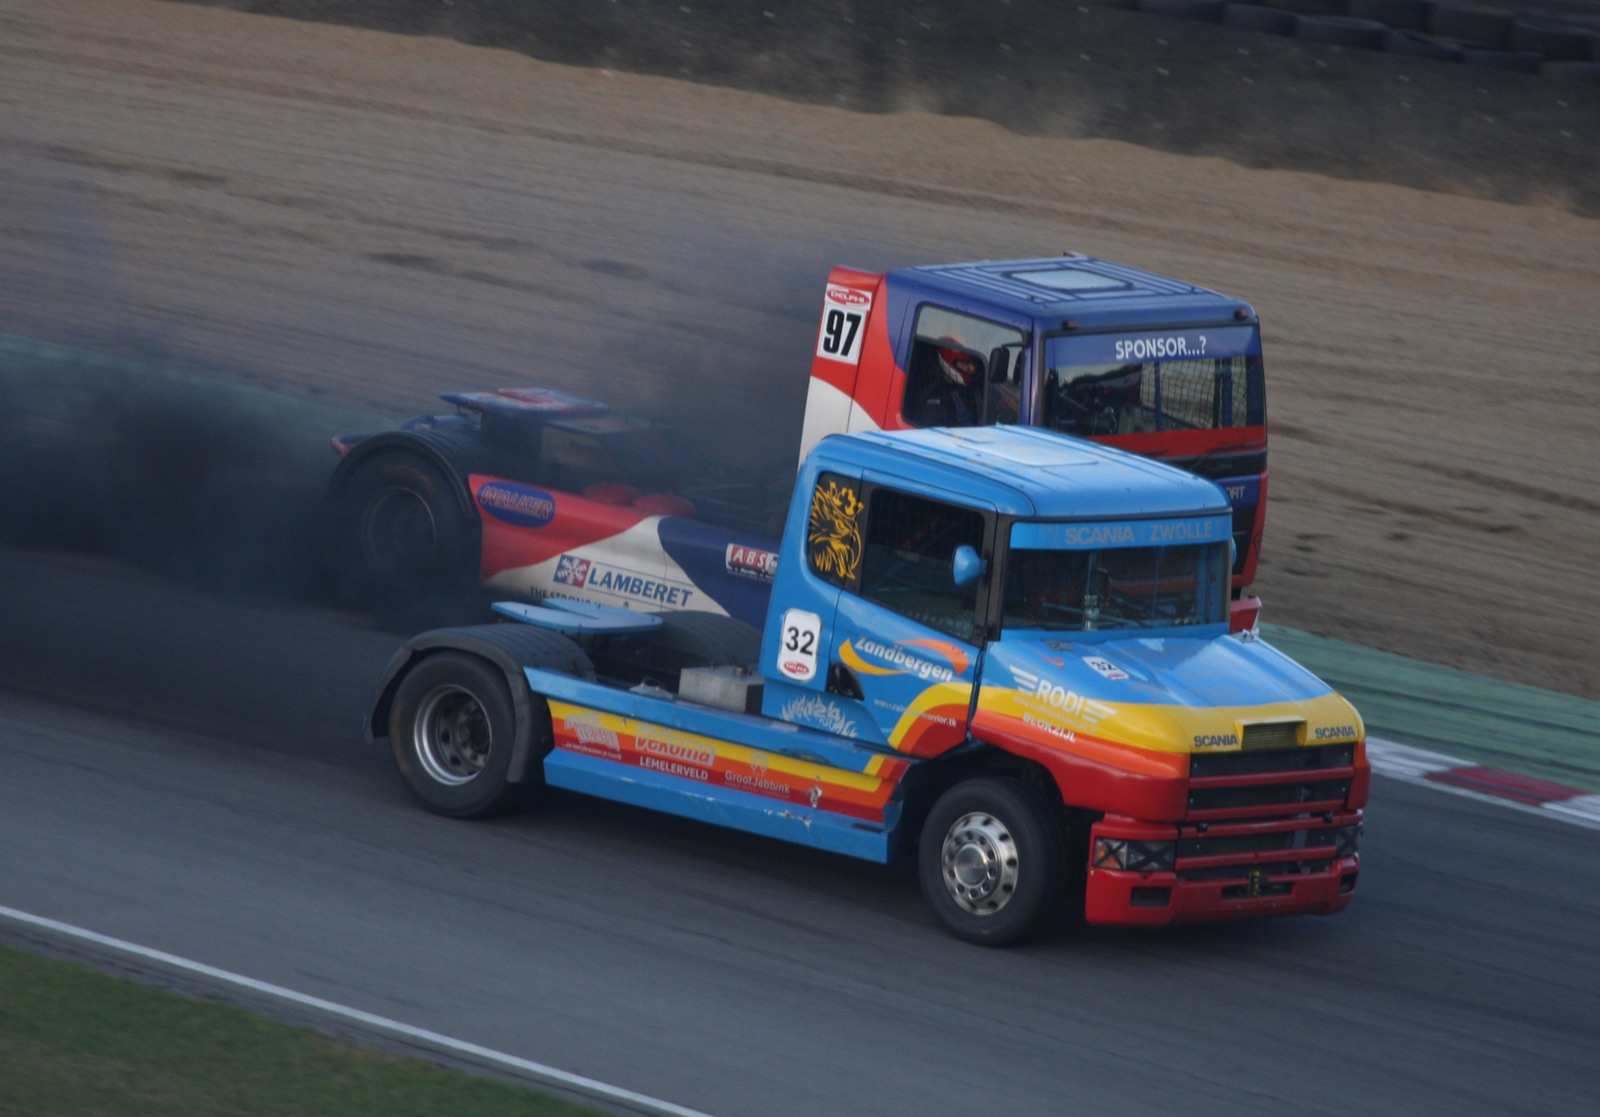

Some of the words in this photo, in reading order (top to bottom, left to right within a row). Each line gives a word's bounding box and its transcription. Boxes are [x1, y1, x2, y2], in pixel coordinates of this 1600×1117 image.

[830, 290, 866, 304] DELPHI
[823, 308, 862, 357] 97
[1115, 335, 1207, 361] SPONSOR...?
[480, 485, 553, 520] WALKER
[1065, 526, 1136, 545] SCANIA
[1149, 520, 1212, 541] ZWOLLE
[732, 546, 767, 568] ABS
[529, 586, 548, 600] THE
[588, 567, 694, 607] LAMBERET
[785, 625, 815, 656] 32
[853, 635, 954, 682] Zandbergen
[1090, 661, 1118, 671] 32
[1036, 679, 1085, 717] RODI
[1023, 712, 1077, 742] BLOKZIJL
[1314, 726, 1356, 740] SCANIA
[636, 722, 714, 766] Vekoma
[1193, 734, 1239, 747] SCANIA
[640, 755, 709, 780] LEMELERVELD
